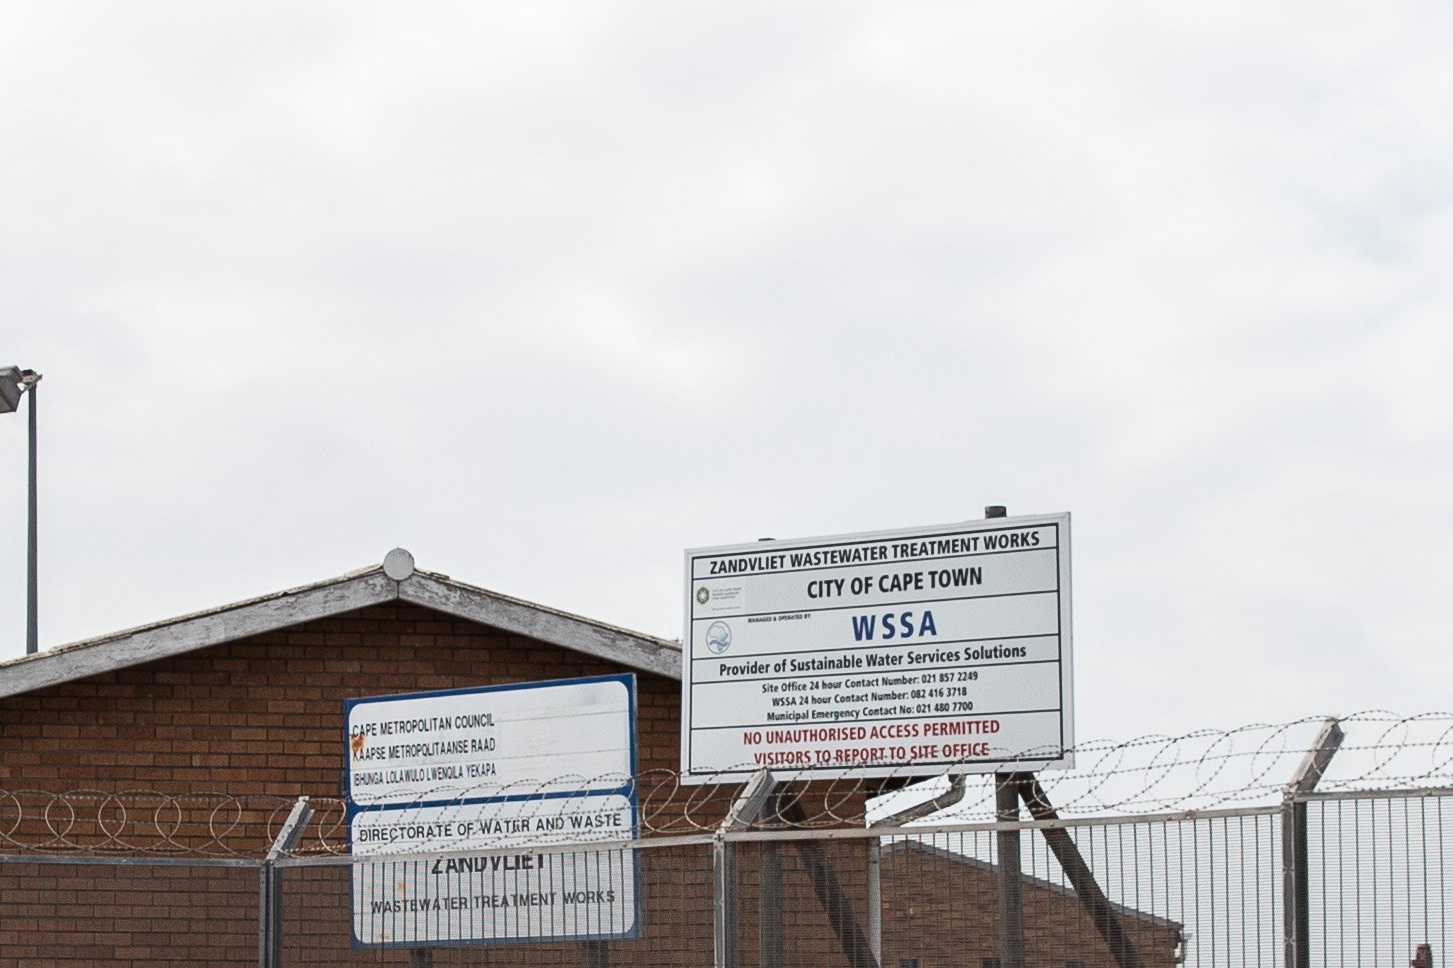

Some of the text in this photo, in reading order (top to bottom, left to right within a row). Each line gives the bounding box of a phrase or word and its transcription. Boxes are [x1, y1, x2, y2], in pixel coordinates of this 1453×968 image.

[710, 531, 1040, 575] ZANDVLIET WASTEWATER TREATMENT WORKS
[807, 567, 982, 598] CITY OF CAPE TOWN
[852, 610, 937, 641] WSSA
[720, 644, 1026, 676] Provider of Sustainable Water Services Solutions
[762, 671, 978, 693] Site Office 24 hour Contact Number: 021 857 2249
[772, 687, 967, 707] WSSA 24 hour Contact Number: 082 416 3718
[767, 701, 973, 722] Municipal Emergency Contact No: 021 480 7700
[352, 713, 495, 737] CAPE METROPOLITAN COUNCIL
[744, 720, 1000, 745] NO UNAUTHORISED ACCESS PERMITTED
[353, 738, 496, 761] KAAPSE METROPOLITAANSE RAAD
[754, 743, 989, 765] VISITORS TO REPORT TO SITE OFFICE
[353, 772, 384, 786] IBHUNGA
[466, 763, 497, 777] YEKAPA
[360, 813, 621, 842] DIRECTORATE OF WATER AND WASTE
[370, 890, 615, 914] WASTEWATER TREATMENT WORKS
